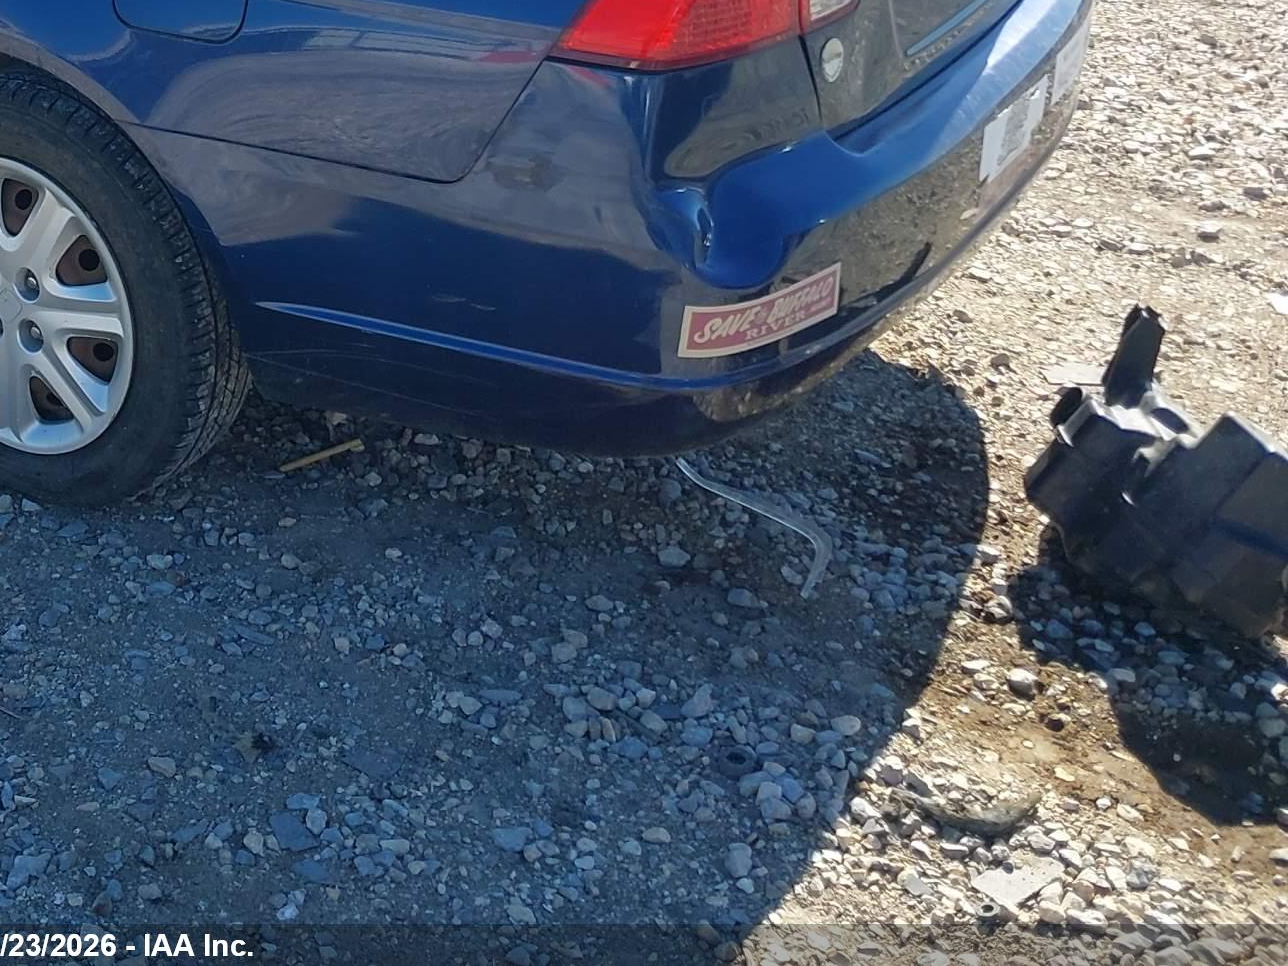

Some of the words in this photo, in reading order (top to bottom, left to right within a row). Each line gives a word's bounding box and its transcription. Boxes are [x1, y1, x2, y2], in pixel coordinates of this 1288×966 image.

[693, 305, 762, 344] SAVE
[766, 276, 834, 323] BUFFALO
[744, 310, 807, 341] RIVER
